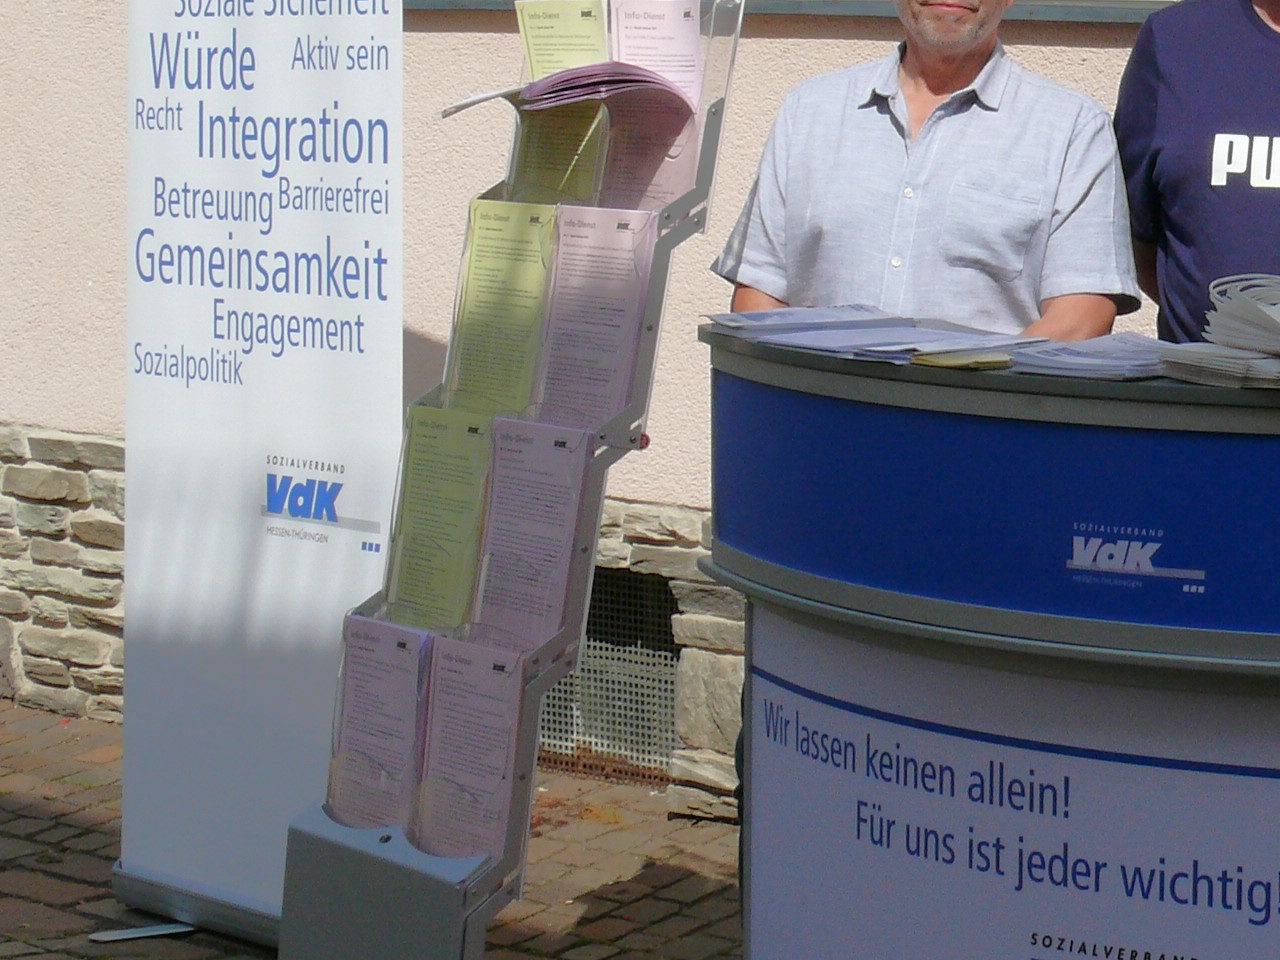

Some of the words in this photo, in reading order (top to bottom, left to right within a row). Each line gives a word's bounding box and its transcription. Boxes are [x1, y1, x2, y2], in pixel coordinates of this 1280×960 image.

[150, 28, 256, 91] Würde
[291, 36, 339, 71] Aktiv
[346, 36, 389, 71] sein
[135, 97, 183, 131] Recht
[198, 100, 389, 178] Integration
[153, 177, 273, 235] Betreuung
[278, 176, 389, 214] Barrierefrei
[135, 227, 388, 301] Gemeinsamkeit
[212, 299, 365, 357] Engagement
[133, 342, 243, 388] Sozialpolitik
[266, 455, 345, 474] SOZIALVERBAND
[267, 473, 344, 522] VdK
[1073, 522, 1164, 537] SOZIALVERBAND
[1072, 536, 1161, 572] VdK
[763, 697, 789, 744] Wir
[796, 711, 856, 774] lassen
[866, 734, 954, 799] keinen
[968, 762, 1071, 819] allein!
[856, 800, 895, 849] Für
[905, 820, 955, 865] uns
[967, 826, 1005, 876] ist
[1014, 838, 1107, 894] jeder
[1030, 933, 1200, 960] SOZIALVERBA
